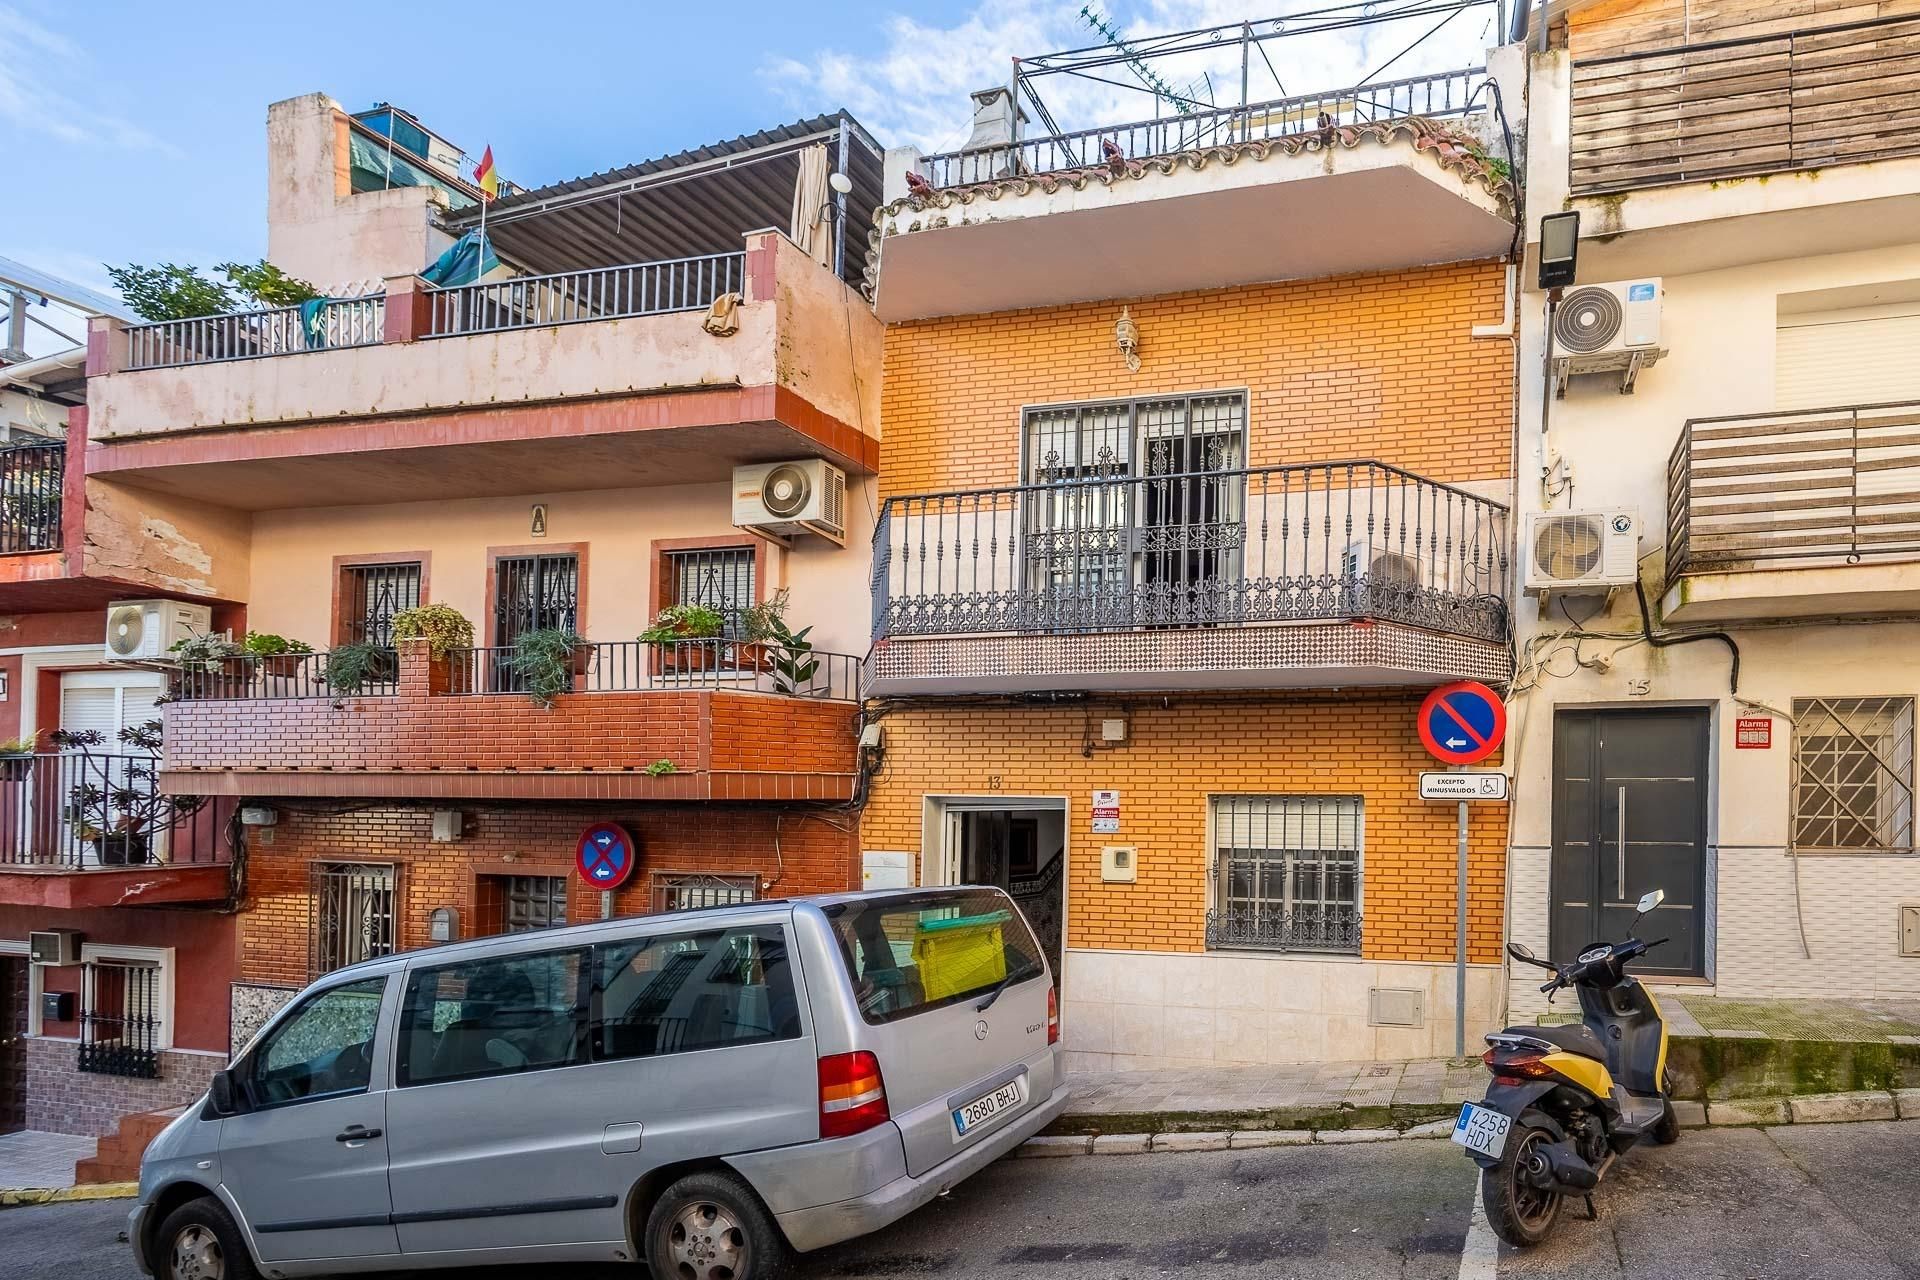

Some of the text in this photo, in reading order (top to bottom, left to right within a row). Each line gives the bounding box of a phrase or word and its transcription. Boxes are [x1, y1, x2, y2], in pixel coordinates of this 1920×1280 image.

[1628, 679, 1651, 696] 15
[1739, 720, 1769, 728] Alarma
[989, 775, 1001, 790] 13
[965, 1086, 1016, 1125] 2680 BHJ
[1471, 1110, 1508, 1135] 4258
[1464, 1127, 1495, 1153] HDX
